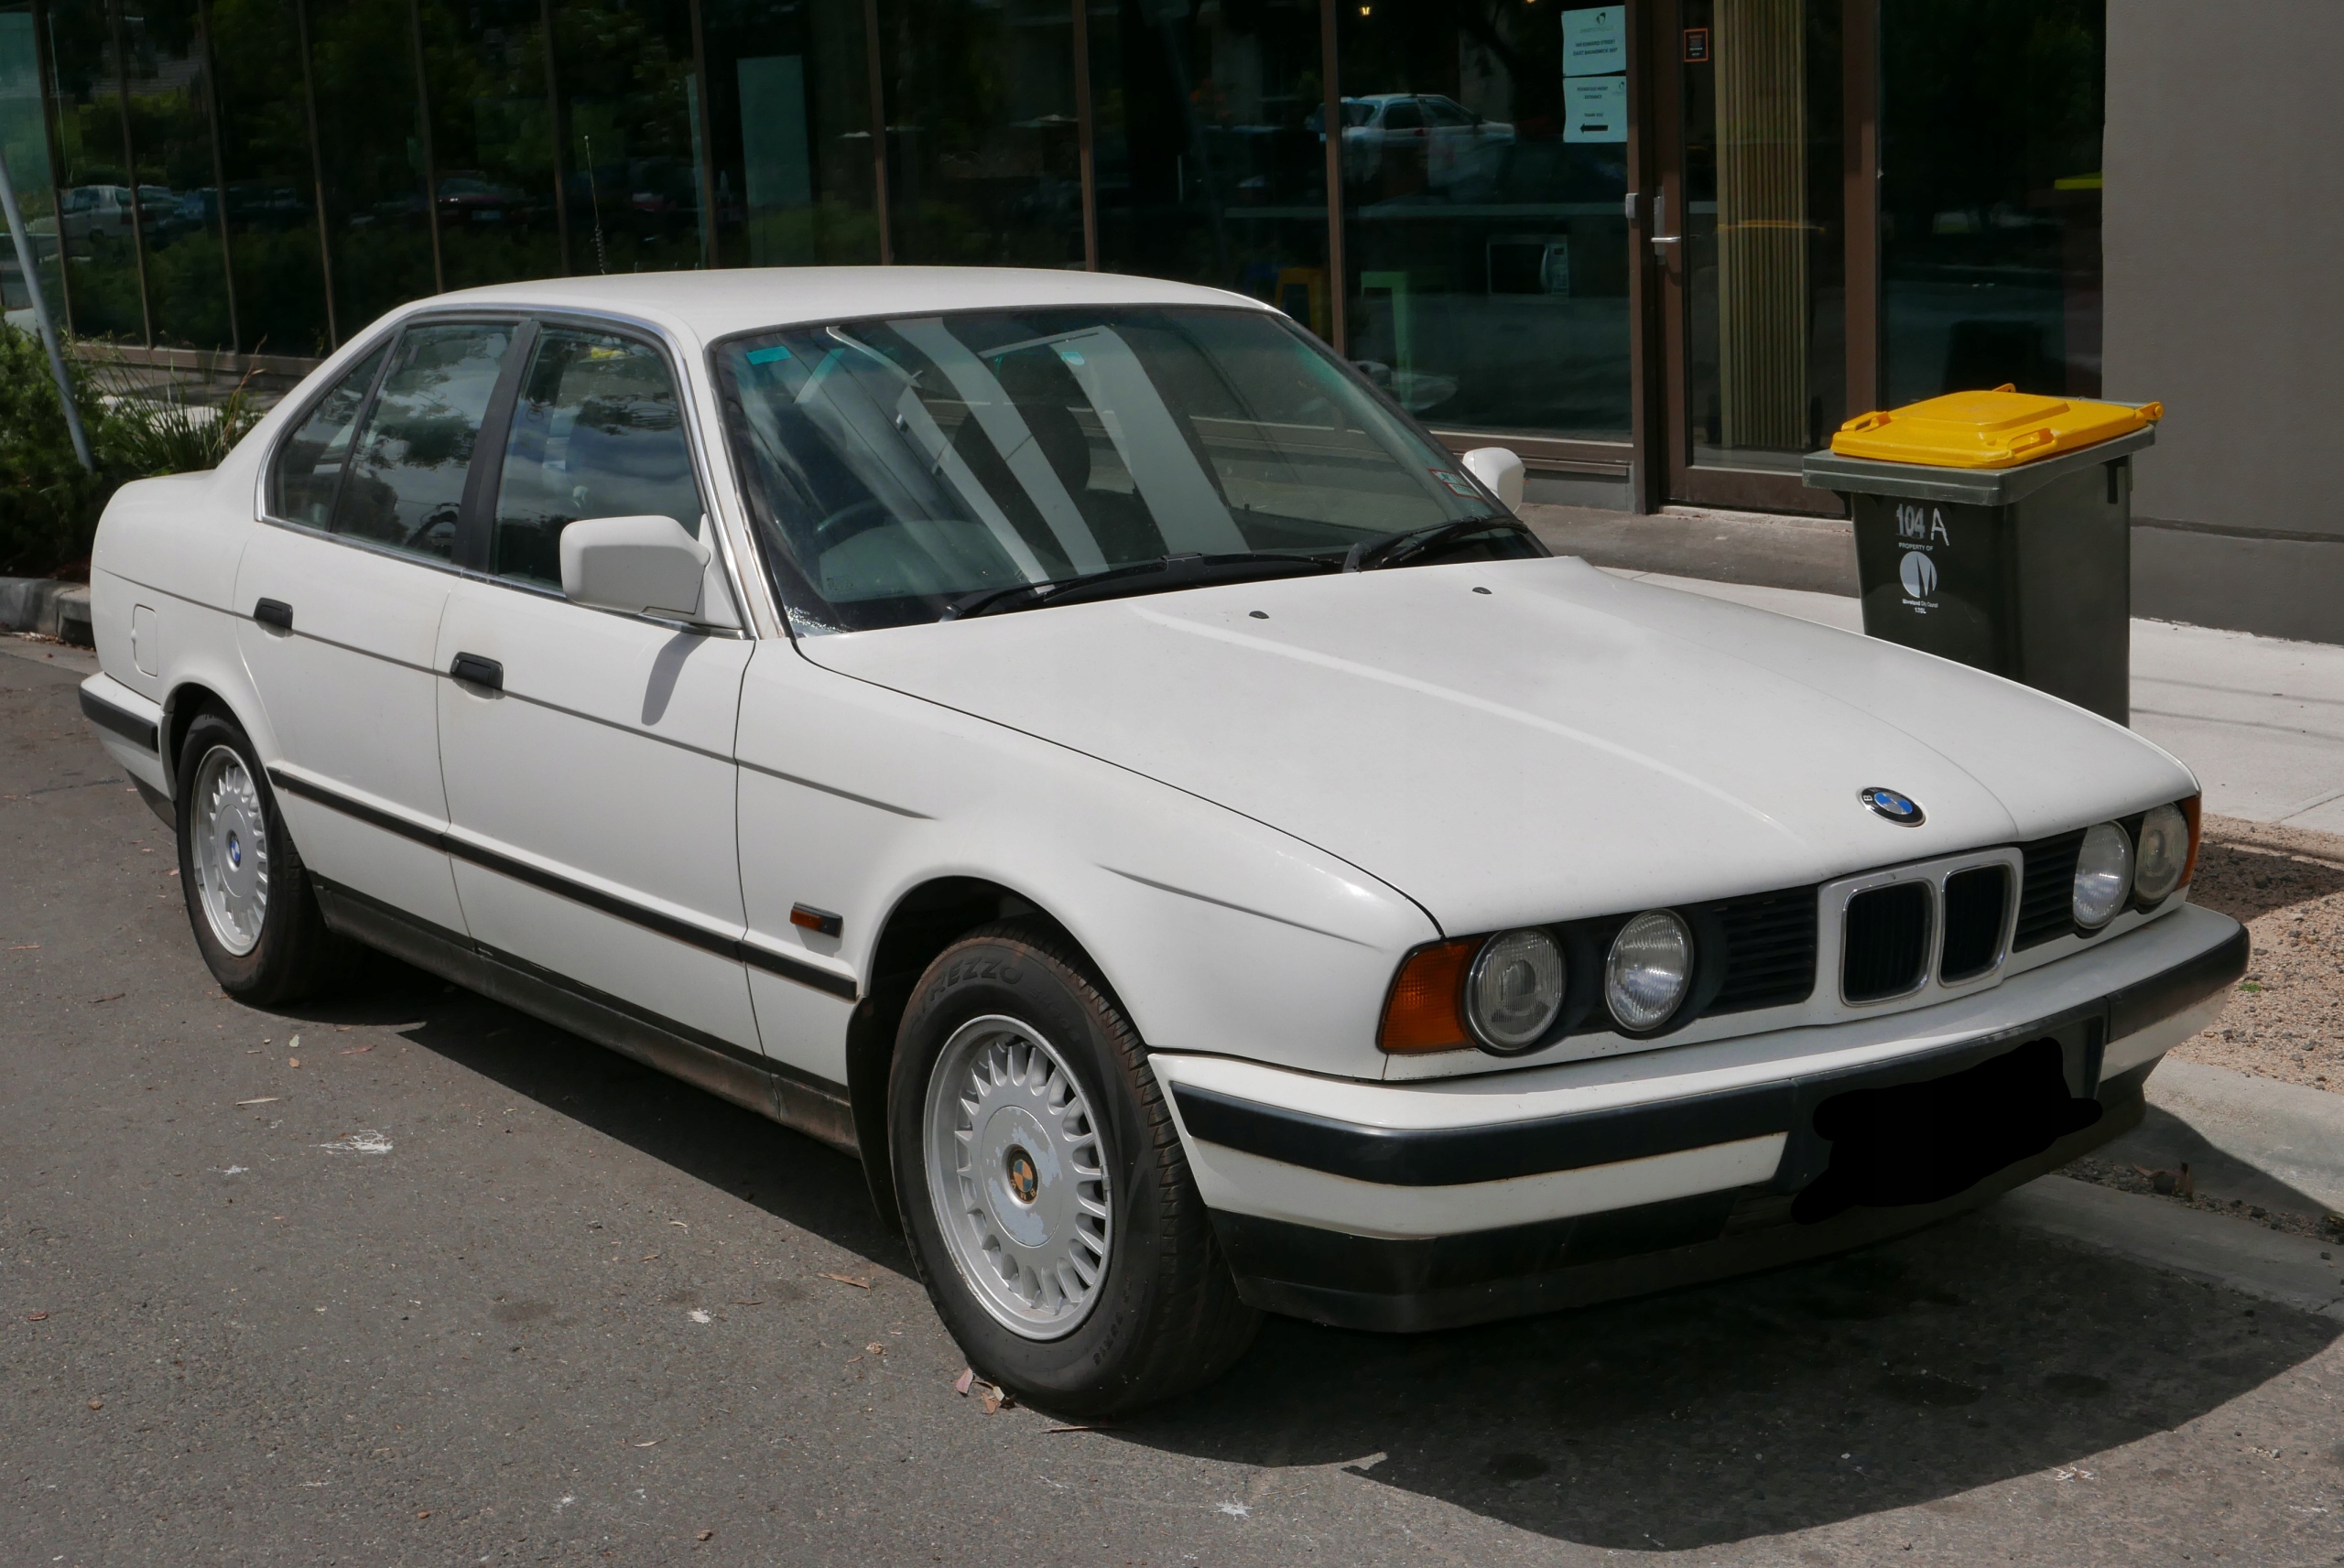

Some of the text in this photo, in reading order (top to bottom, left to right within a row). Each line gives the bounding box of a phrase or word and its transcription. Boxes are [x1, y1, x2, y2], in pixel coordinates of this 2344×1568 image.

[1895, 503, 1949, 546] 104 A
[1898, 542, 1926, 550] PROPERTY
